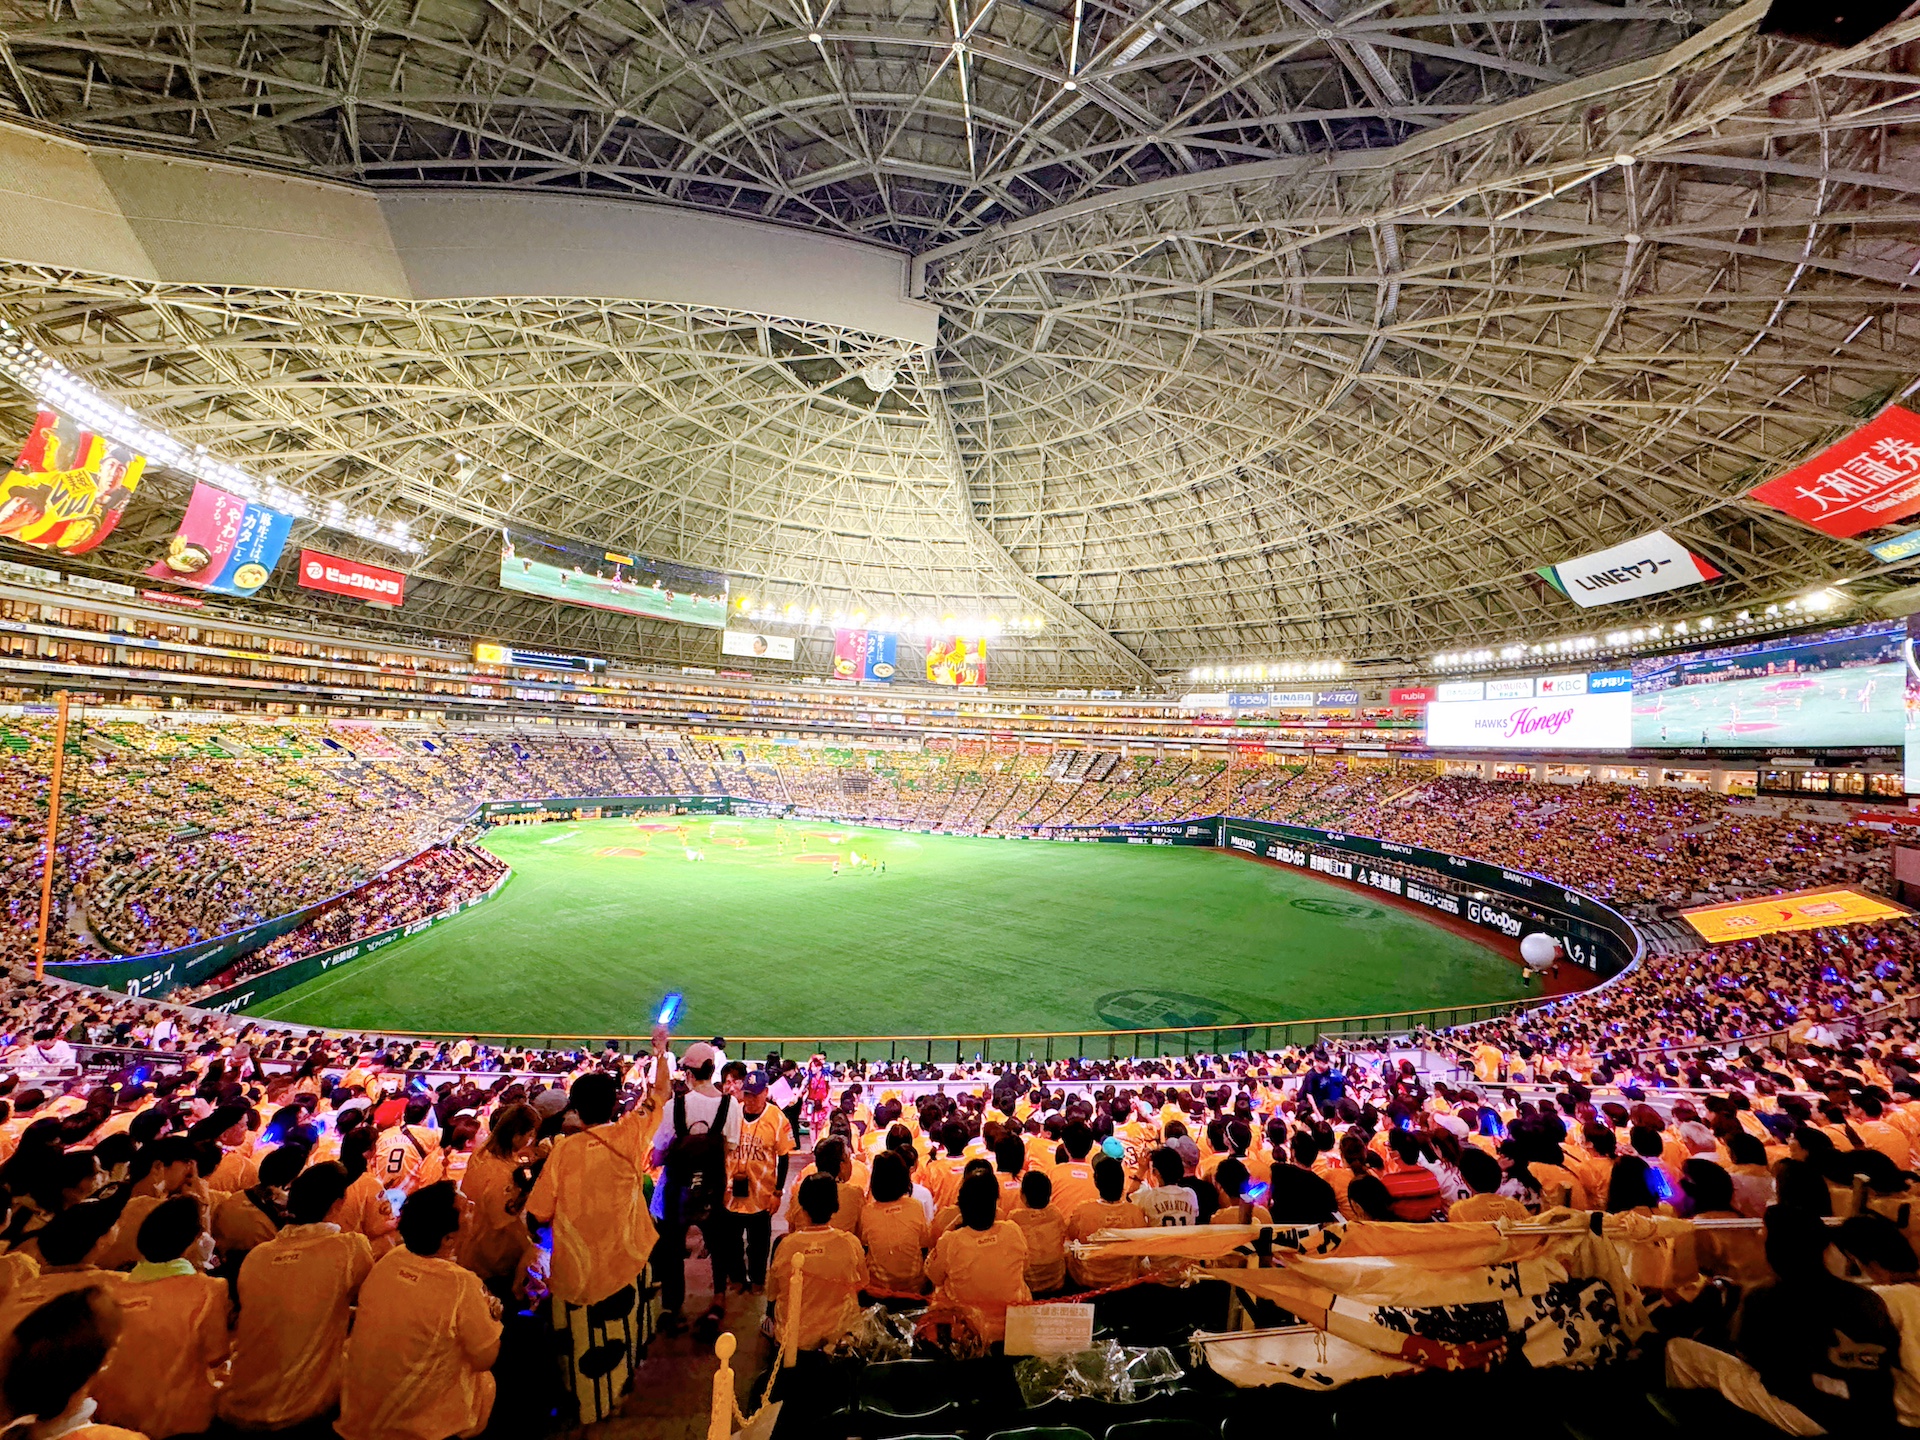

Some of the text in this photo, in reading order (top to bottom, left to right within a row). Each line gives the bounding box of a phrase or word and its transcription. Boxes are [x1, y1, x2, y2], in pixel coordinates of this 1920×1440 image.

[1794, 437, 1920, 511] 大和証券
[325, 567, 399, 595] ビックカメラ
[1574, 559, 1671, 591] LINEヤフー
[1401, 692, 1425, 700] nubia
[1490, 682, 1528, 691] NOMURA
[1557, 680, 1581, 691] KBC
[1239, 695, 1267, 704] ろうきん
[1475, 706, 1574, 738] HAWKS Honeys
[1503, 871, 1532, 887] SANKYU
[1482, 906, 1522, 937] GooDay
[387, 1148, 405, 1173] 9
